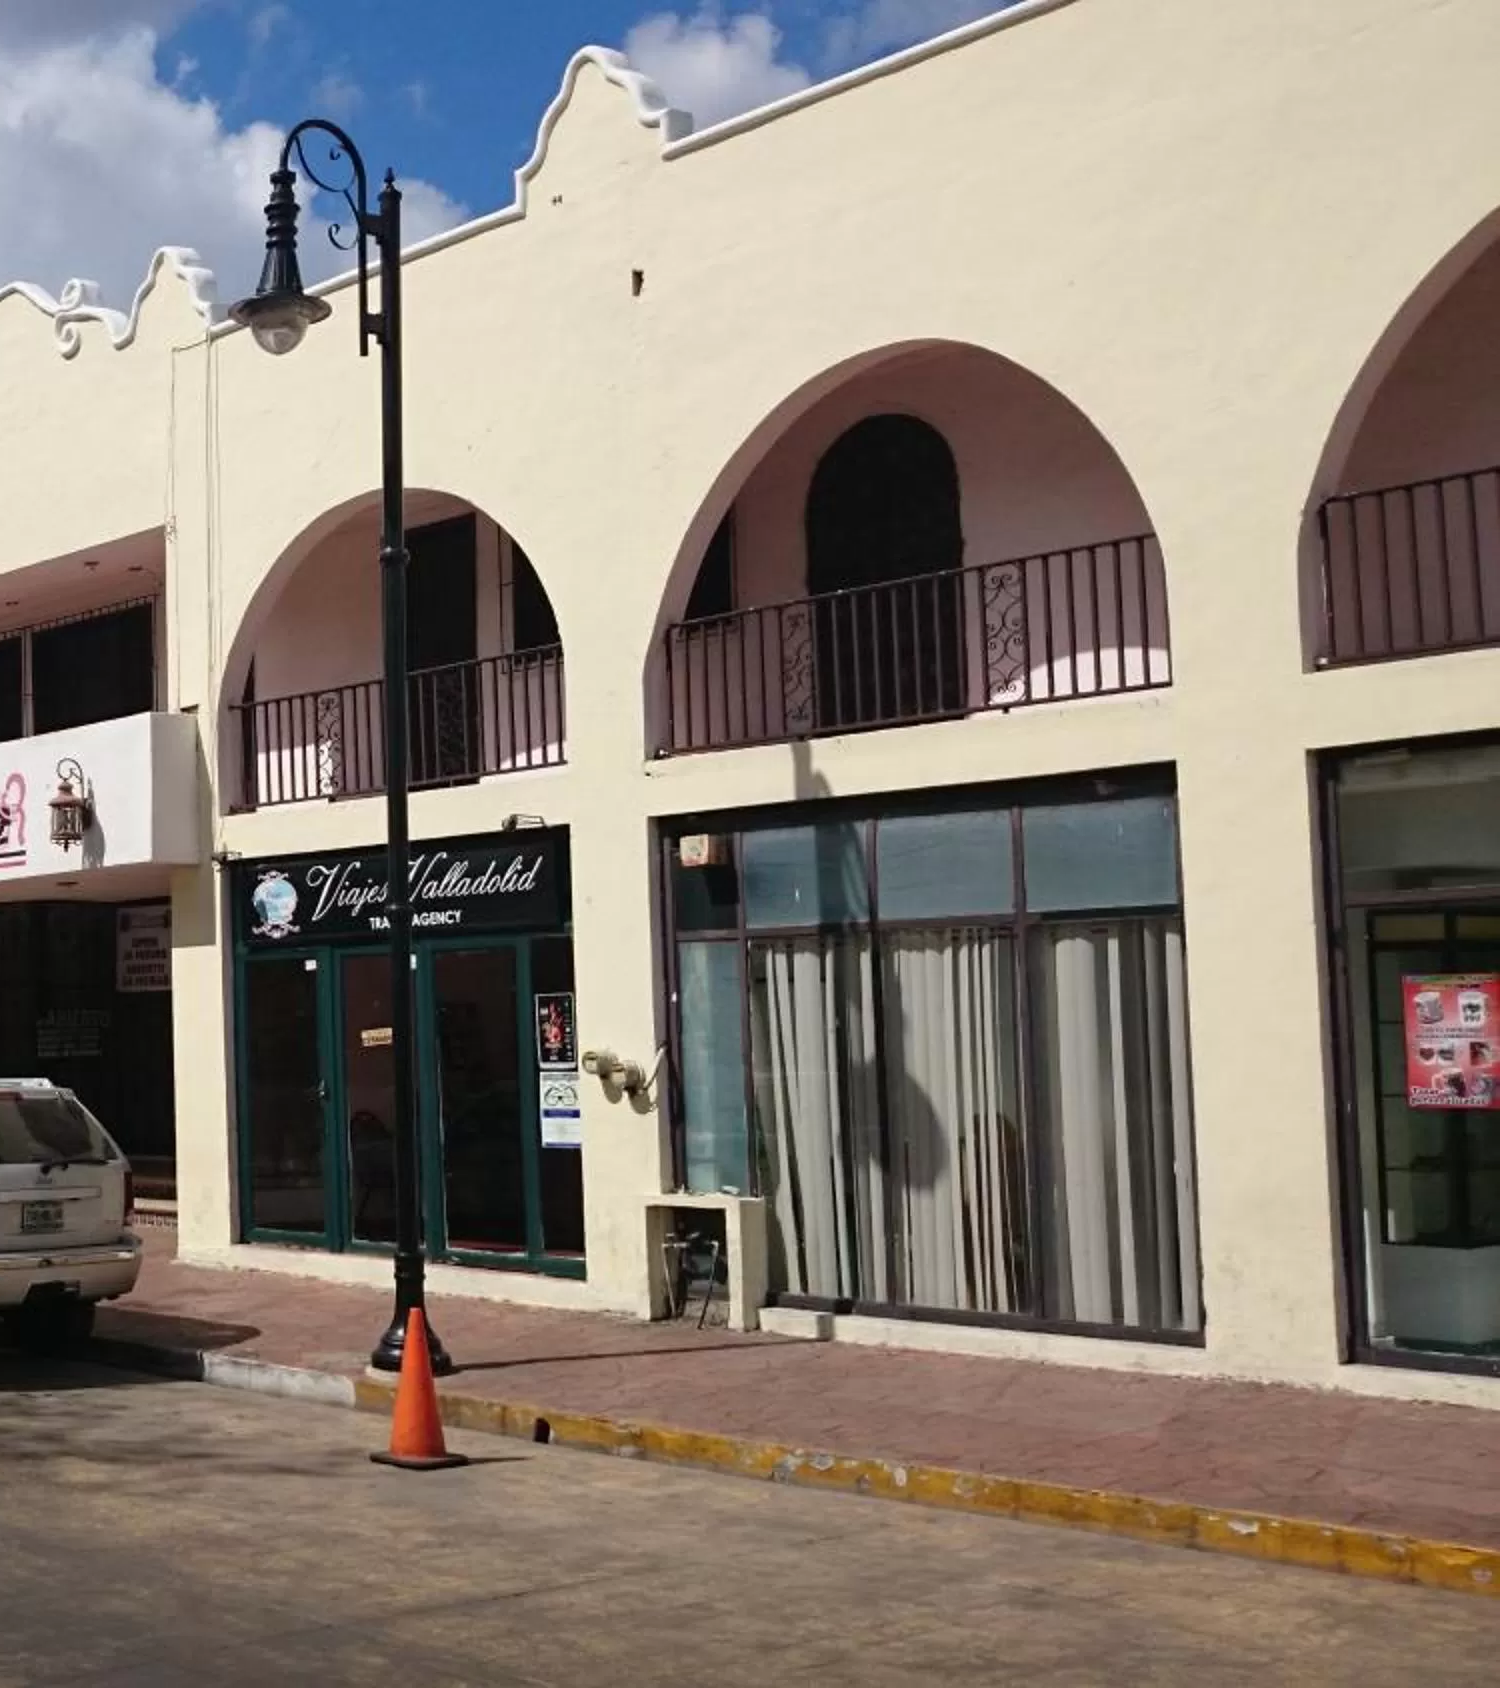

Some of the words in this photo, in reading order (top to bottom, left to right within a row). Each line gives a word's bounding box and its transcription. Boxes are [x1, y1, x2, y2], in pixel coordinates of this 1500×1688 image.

[305, 861, 389, 923] Viajes
[408, 851, 543, 903] Valladolid
[369, 915, 392, 930] TRA
[411, 909, 462, 927] AGENCY
